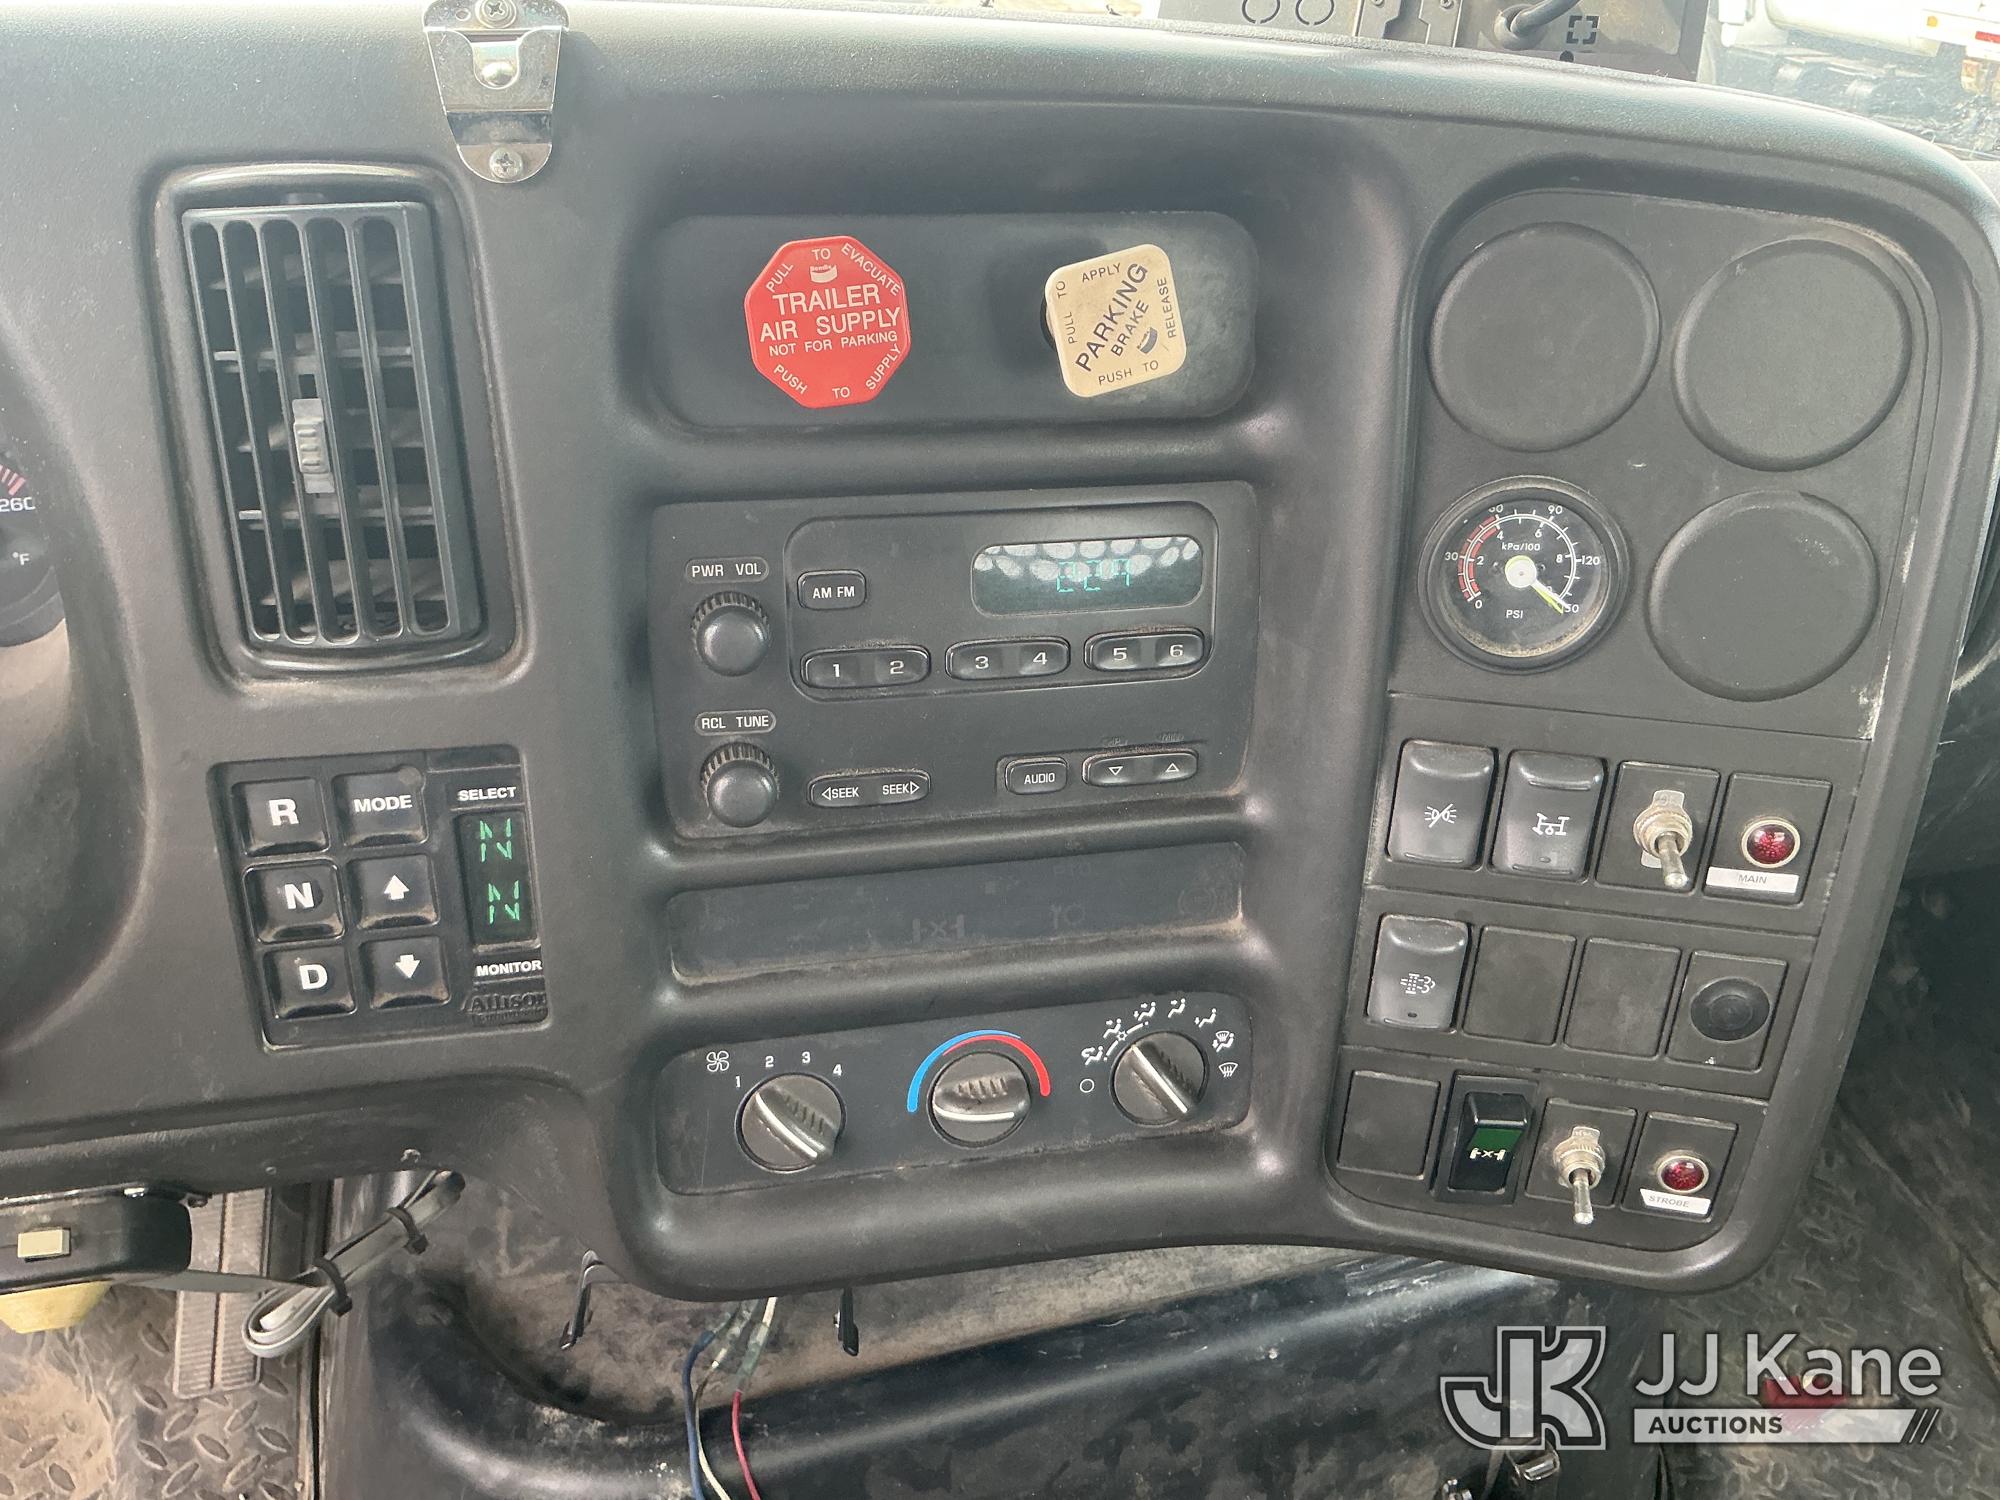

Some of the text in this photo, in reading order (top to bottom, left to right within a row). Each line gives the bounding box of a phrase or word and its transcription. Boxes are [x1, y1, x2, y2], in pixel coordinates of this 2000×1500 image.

[766, 243, 901, 296] PULL TO EVACUATE
[772, 283, 881, 316] TRAILER
[1056, 262, 1121, 344] PULL TO APPLY
[760, 307, 900, 342] AIR SUPPLY
[1075, 263, 1148, 372] PARKING
[1098, 368, 1132, 385] PUSH
[1143, 360, 1159, 372] TO
[1157, 277, 1177, 338] RELEASE
[1110, 300, 1149, 357] BRAKE
[769, 331, 897, 357] NOT FOR PARKING
[774, 344, 901, 399] PUSH TO SUPPLY
[1548, 505, 1563, 515] 90
[1496, 531, 1504, 540] 4
[1535, 529, 1542, 538] 6
[1444, 552, 1458, 561] 30
[1476, 555, 1484, 565] 2
[1556, 554, 1563, 563] 8
[1582, 555, 1600, 565] 120
[692, 562, 761, 577] PWR VOL
[813, 585, 855, 599] AM FM
[1475, 600, 1483, 609] 0
[1506, 609, 1524, 619] PSI
[975, 651, 1048, 669] 3 4
[1113, 644, 1184, 661] 5 6
[832, 660, 905, 678] 1 2
[701, 715, 769, 729] RCL TUNE
[1024, 772, 1055, 785] AUDIO
[458, 786, 517, 801] SELECT
[831, 786, 859, 798] SEEK
[882, 783, 910, 795] SEEK
[354, 795, 413, 813] MODE
[268, 798, 299, 826] R
[479, 818, 513, 862] N
[1738, 874, 1768, 884] MAIN
[284, 882, 315, 910] N
[488, 880, 520, 925] N
[476, 959, 543, 977] MONITOR
[299, 964, 328, 990] D
[765, 1055, 774, 1068] 2
[801, 1051, 811, 1064] 3
[833, 1064, 842, 1076] 4
[735, 1075, 741, 1088] 1
[1649, 1195, 1690, 1208] STROBE
